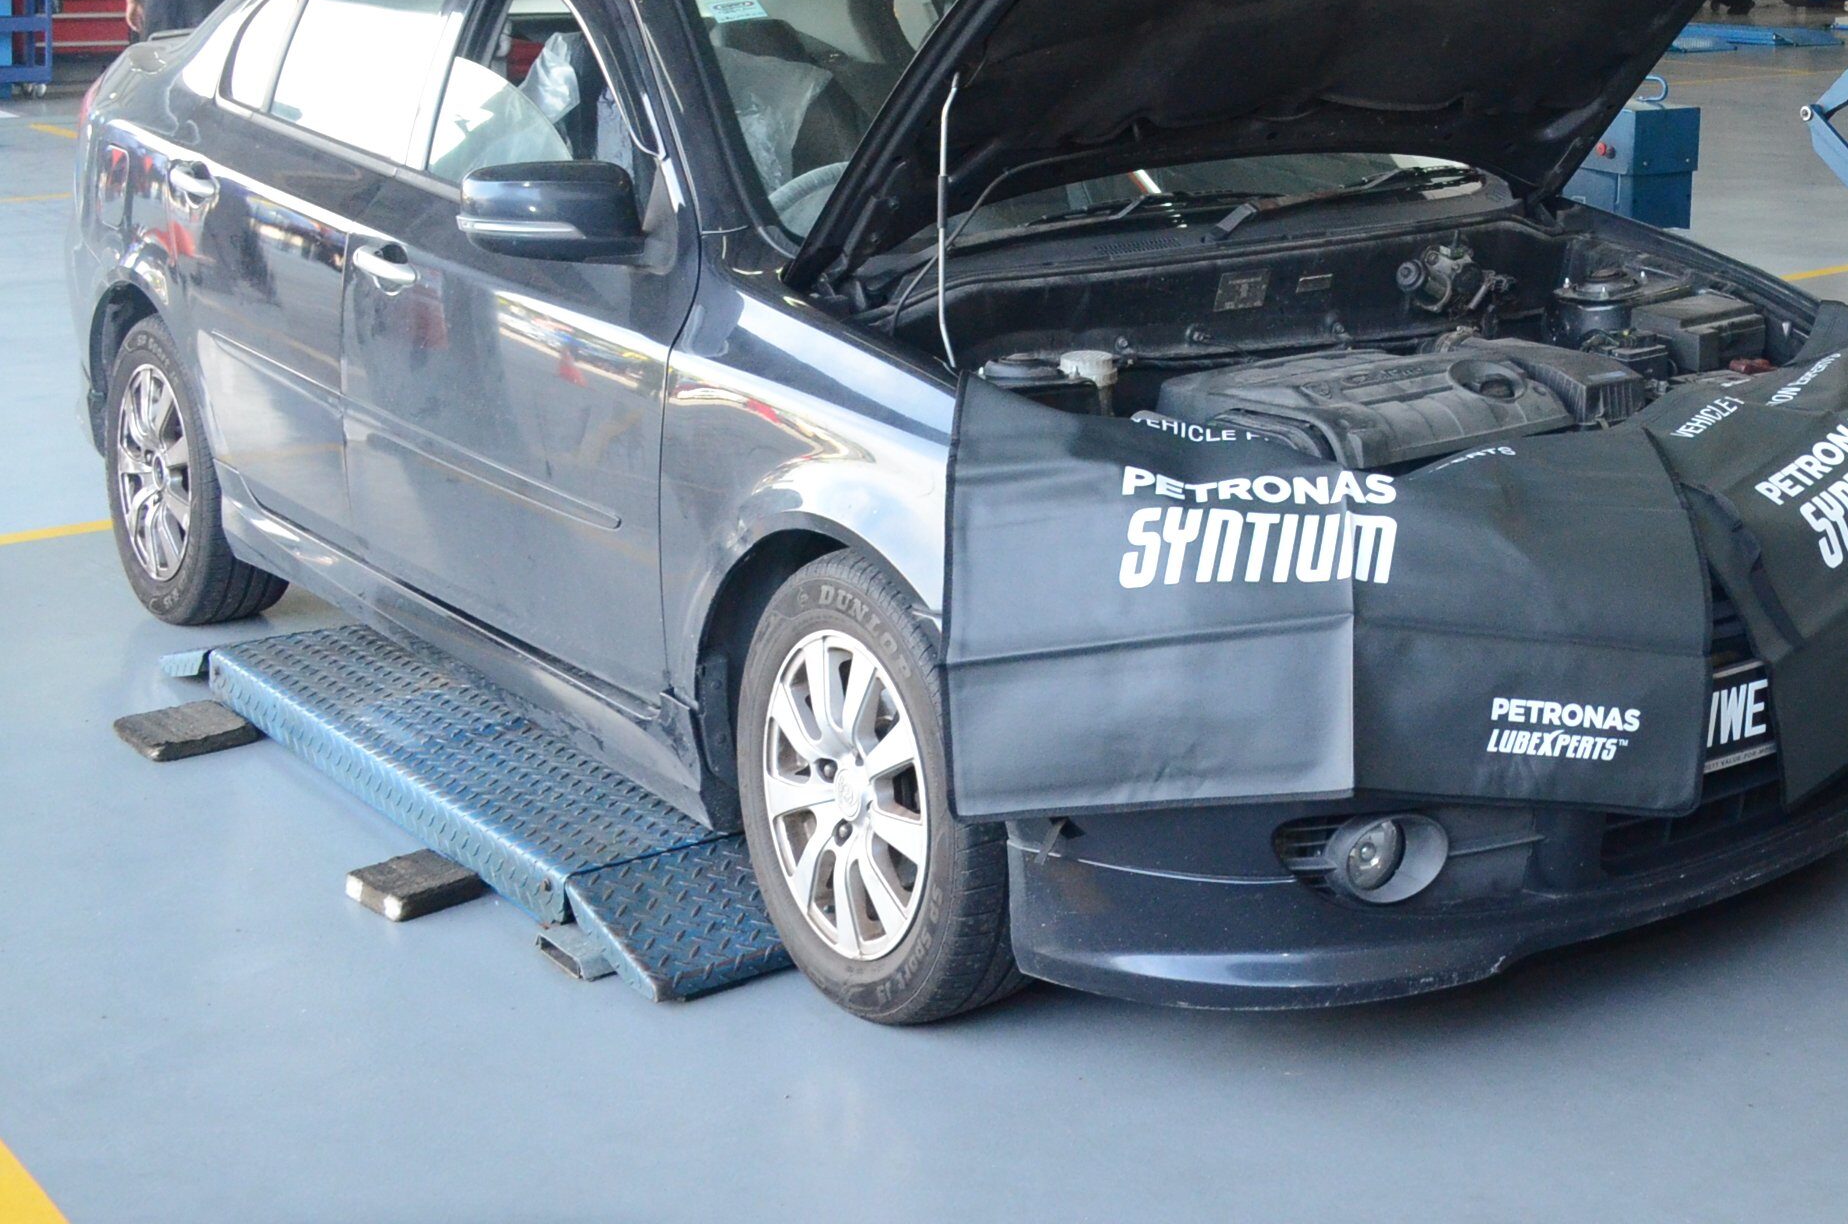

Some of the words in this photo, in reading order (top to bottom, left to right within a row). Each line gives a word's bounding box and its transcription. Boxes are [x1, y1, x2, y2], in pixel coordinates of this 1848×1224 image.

[1670, 399, 1738, 438] VEHICLE
[1122, 465, 1397, 505] PETRONAS
[1119, 506, 1398, 589] SYNTIUM
[818, 584, 911, 678] DUNLOP
[1491, 697, 1641, 732] PETRONAS
